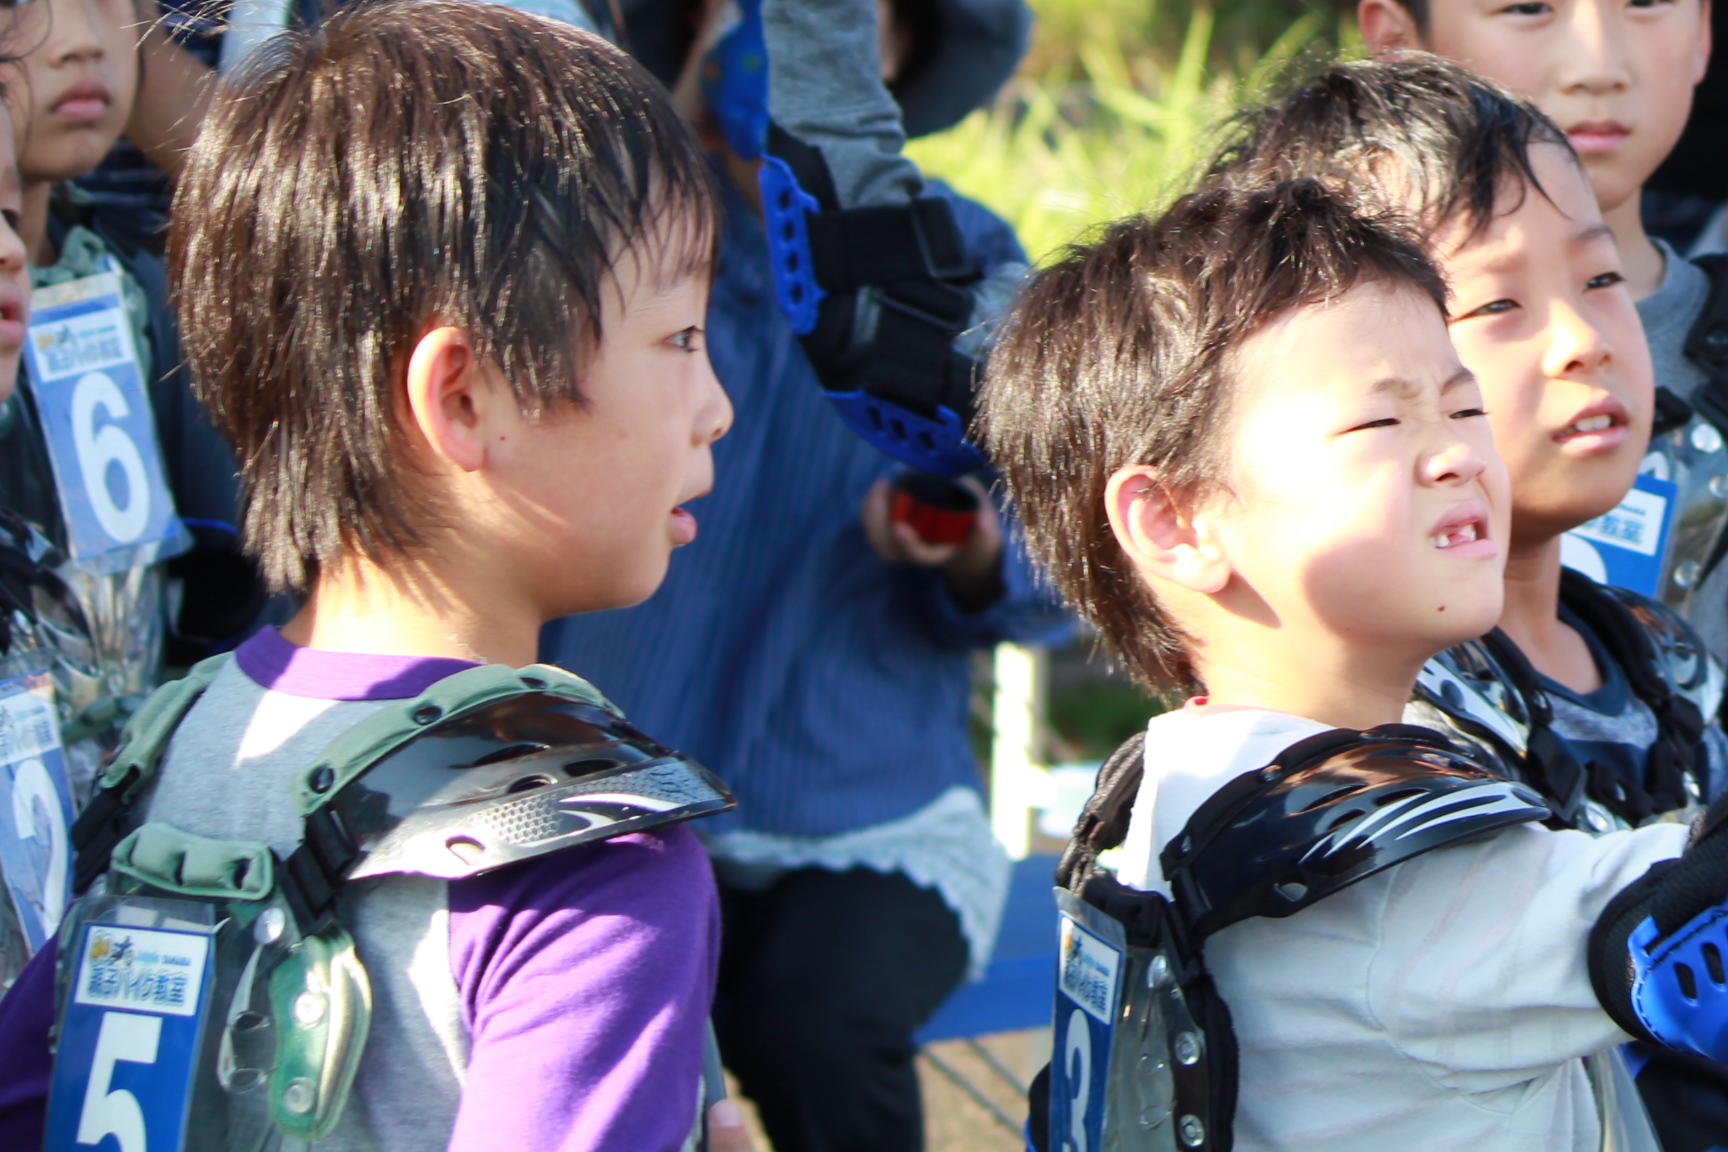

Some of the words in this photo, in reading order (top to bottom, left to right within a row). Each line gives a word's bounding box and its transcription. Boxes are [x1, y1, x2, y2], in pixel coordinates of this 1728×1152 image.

[71, 371, 149, 542] 6
[75, 1010, 164, 1152] 5
[1063, 1008, 1092, 1152] 3
